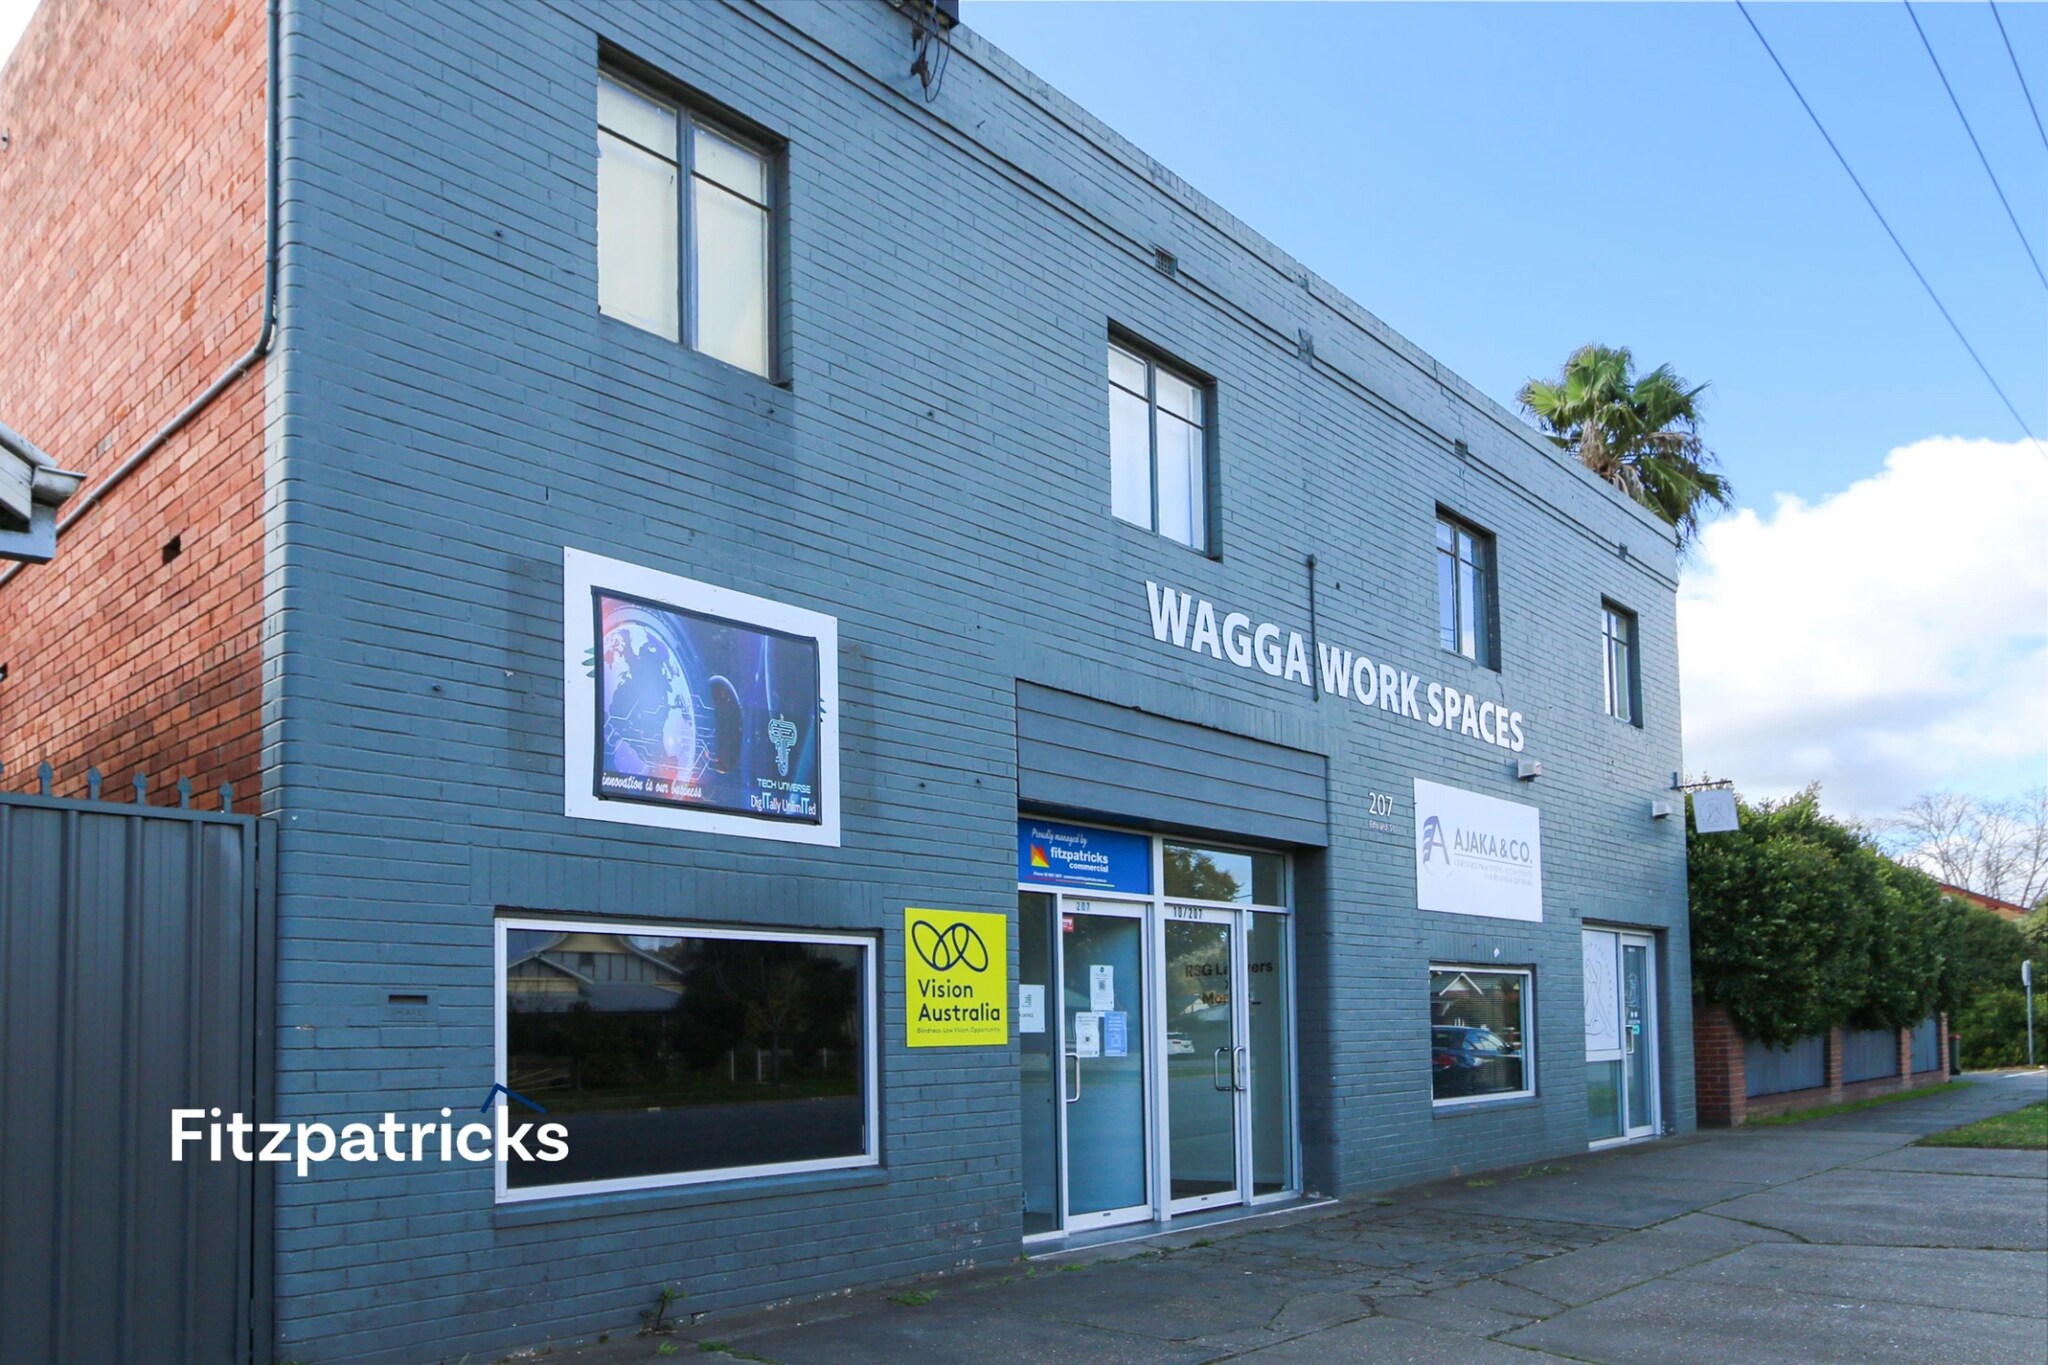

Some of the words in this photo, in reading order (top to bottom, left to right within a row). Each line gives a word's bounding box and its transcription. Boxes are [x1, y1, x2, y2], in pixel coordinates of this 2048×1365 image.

[1145, 580, 1311, 686] WAGGA
[1318, 641, 1422, 721] WORK
[1427, 681, 1524, 752] SPACES
[602, 772, 643, 791] innovation
[645, 779, 653, 792] is
[655, 784, 669, 793] our
[671, 779, 702, 797] business
[757, 777, 777, 789] TECH
[777, 781, 811, 794] UNIVERSE
[1369, 792, 1393, 817] 207
[1031, 827, 1054, 844] Proudly
[1055, 833, 1079, 847] managed
[1080, 834, 1088, 848] by
[1454, 828, 1498, 857] AJAKA
[1050, 846, 1109, 864] fitzpatricks
[1069, 862, 1109, 873] commercial
[1076, 901, 1091, 912] 207
[1172, 906, 1203, 920] 10/207
[1185, 963, 1212, 977] RSG
[918, 979, 973, 998] Vision
[918, 1002, 1000, 1022] Australia
